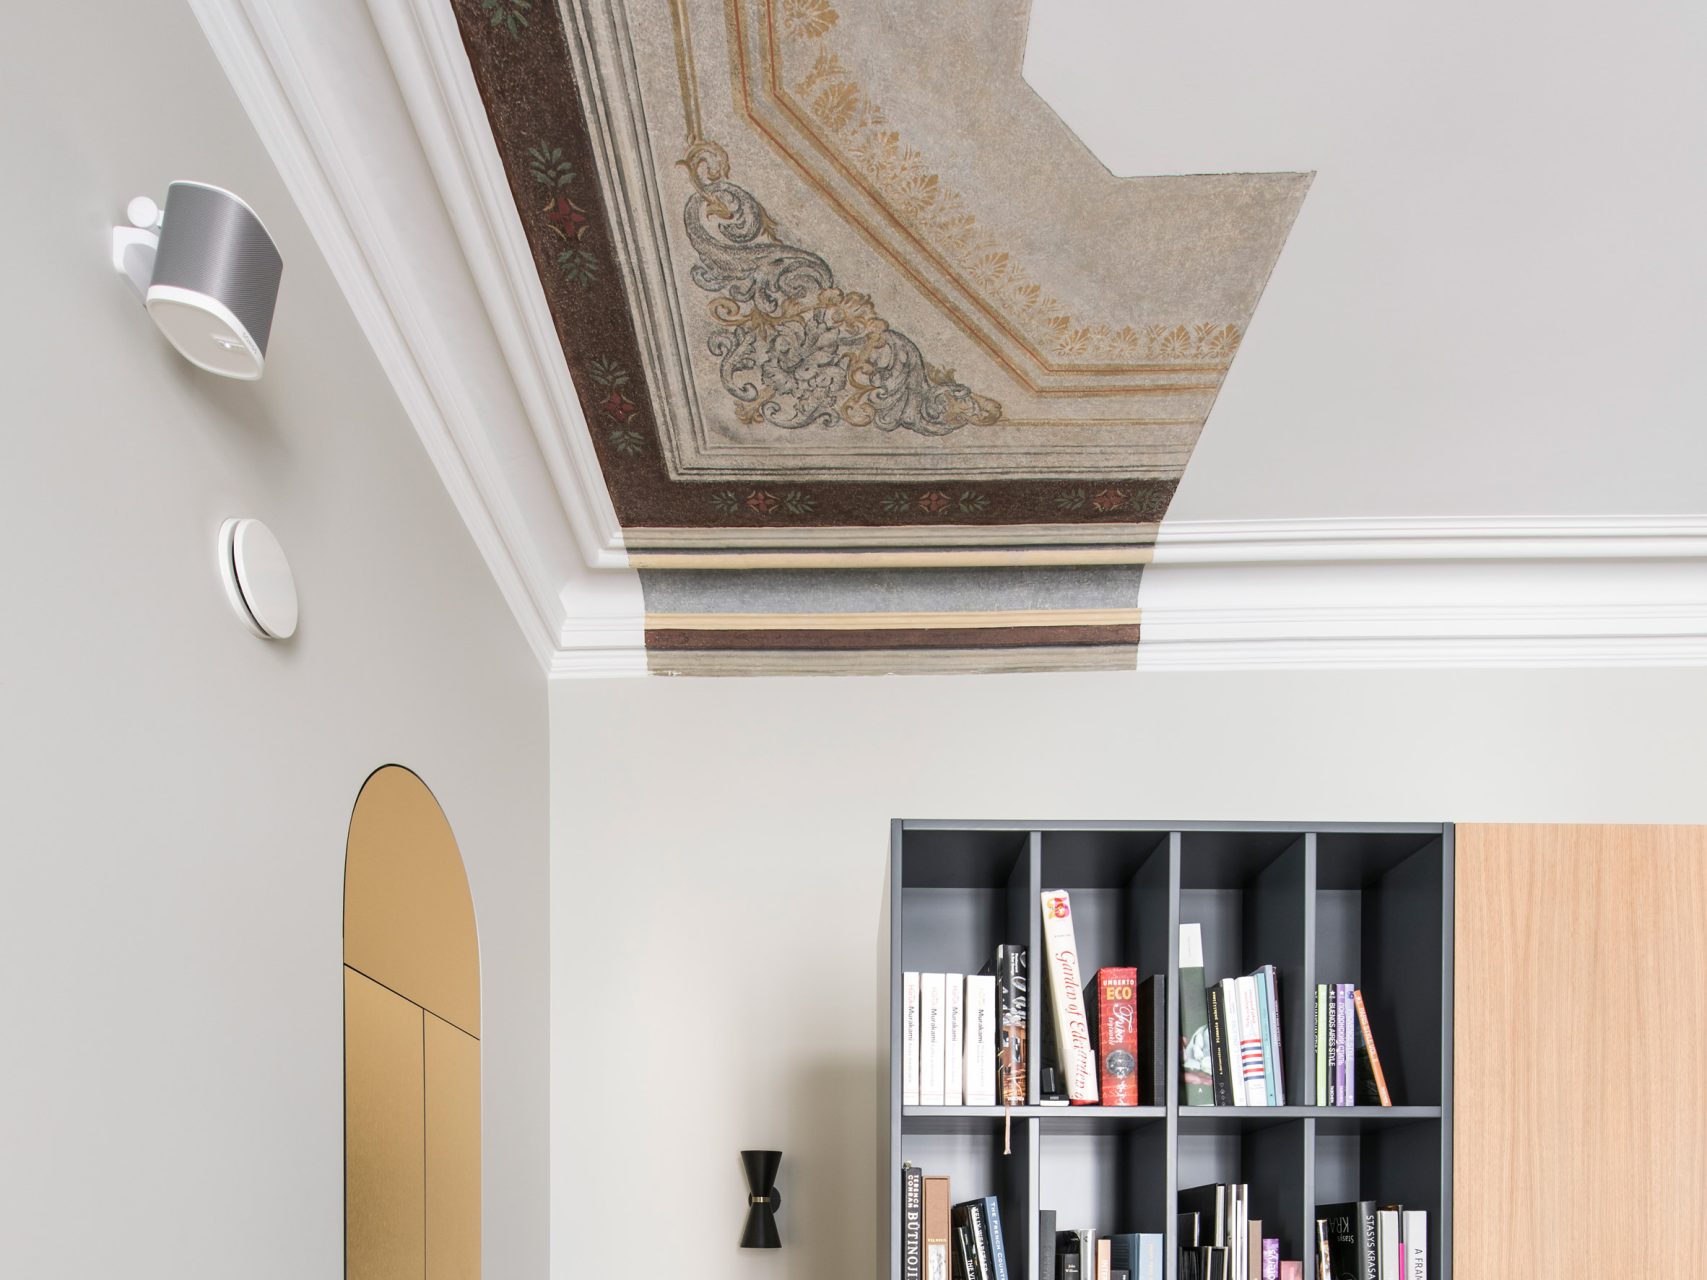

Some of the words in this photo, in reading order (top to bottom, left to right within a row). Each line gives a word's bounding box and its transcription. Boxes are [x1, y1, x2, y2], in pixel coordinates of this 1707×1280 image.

[1055, 950, 1081, 1000] Garden
[1103, 979, 1135, 987] UMBERTO
[1065, 1003, 1083, 1016] of
[1106, 987, 1132, 1001] ECO
[907, 1006, 915, 1041] Murakami
[930, 1008, 938, 1043] Murakami
[951, 1007, 959, 1041] Murakami
[977, 1009, 985, 1043] Murakami
[992, 1219, 1000, 1247] FRENCH
[1366, 1215, 1375, 1247] STASYS
